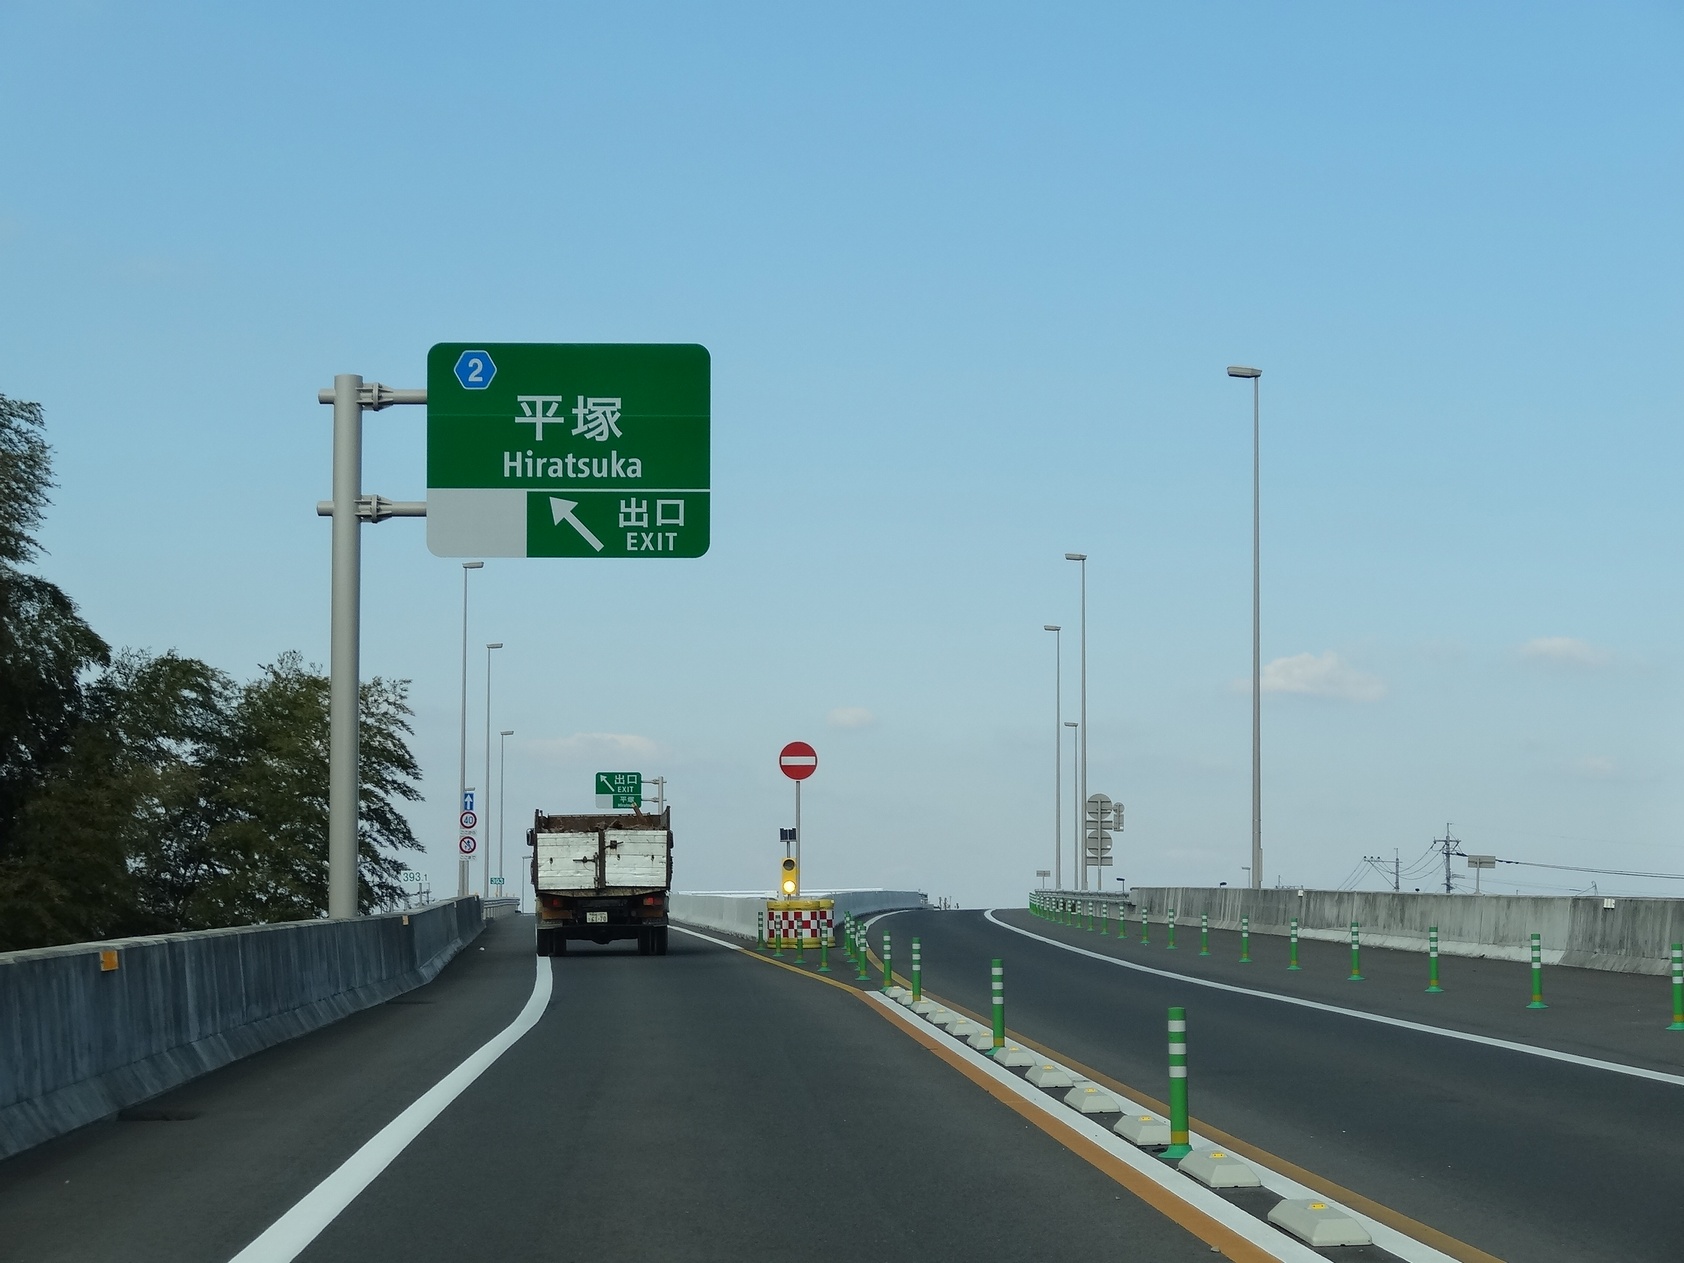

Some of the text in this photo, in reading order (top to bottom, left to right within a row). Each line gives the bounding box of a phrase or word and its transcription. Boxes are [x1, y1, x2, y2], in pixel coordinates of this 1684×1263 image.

[468, 358, 483, 382] 2
[514, 395, 623, 442] 平塚
[503, 449, 642, 478] Hiratsuka
[618, 497, 685, 528] 出口
[626, 532, 678, 551] EXIT
[614, 774, 637, 785] 出口
[463, 816, 474, 824] 40
[402, 872, 428, 882] 393.1
